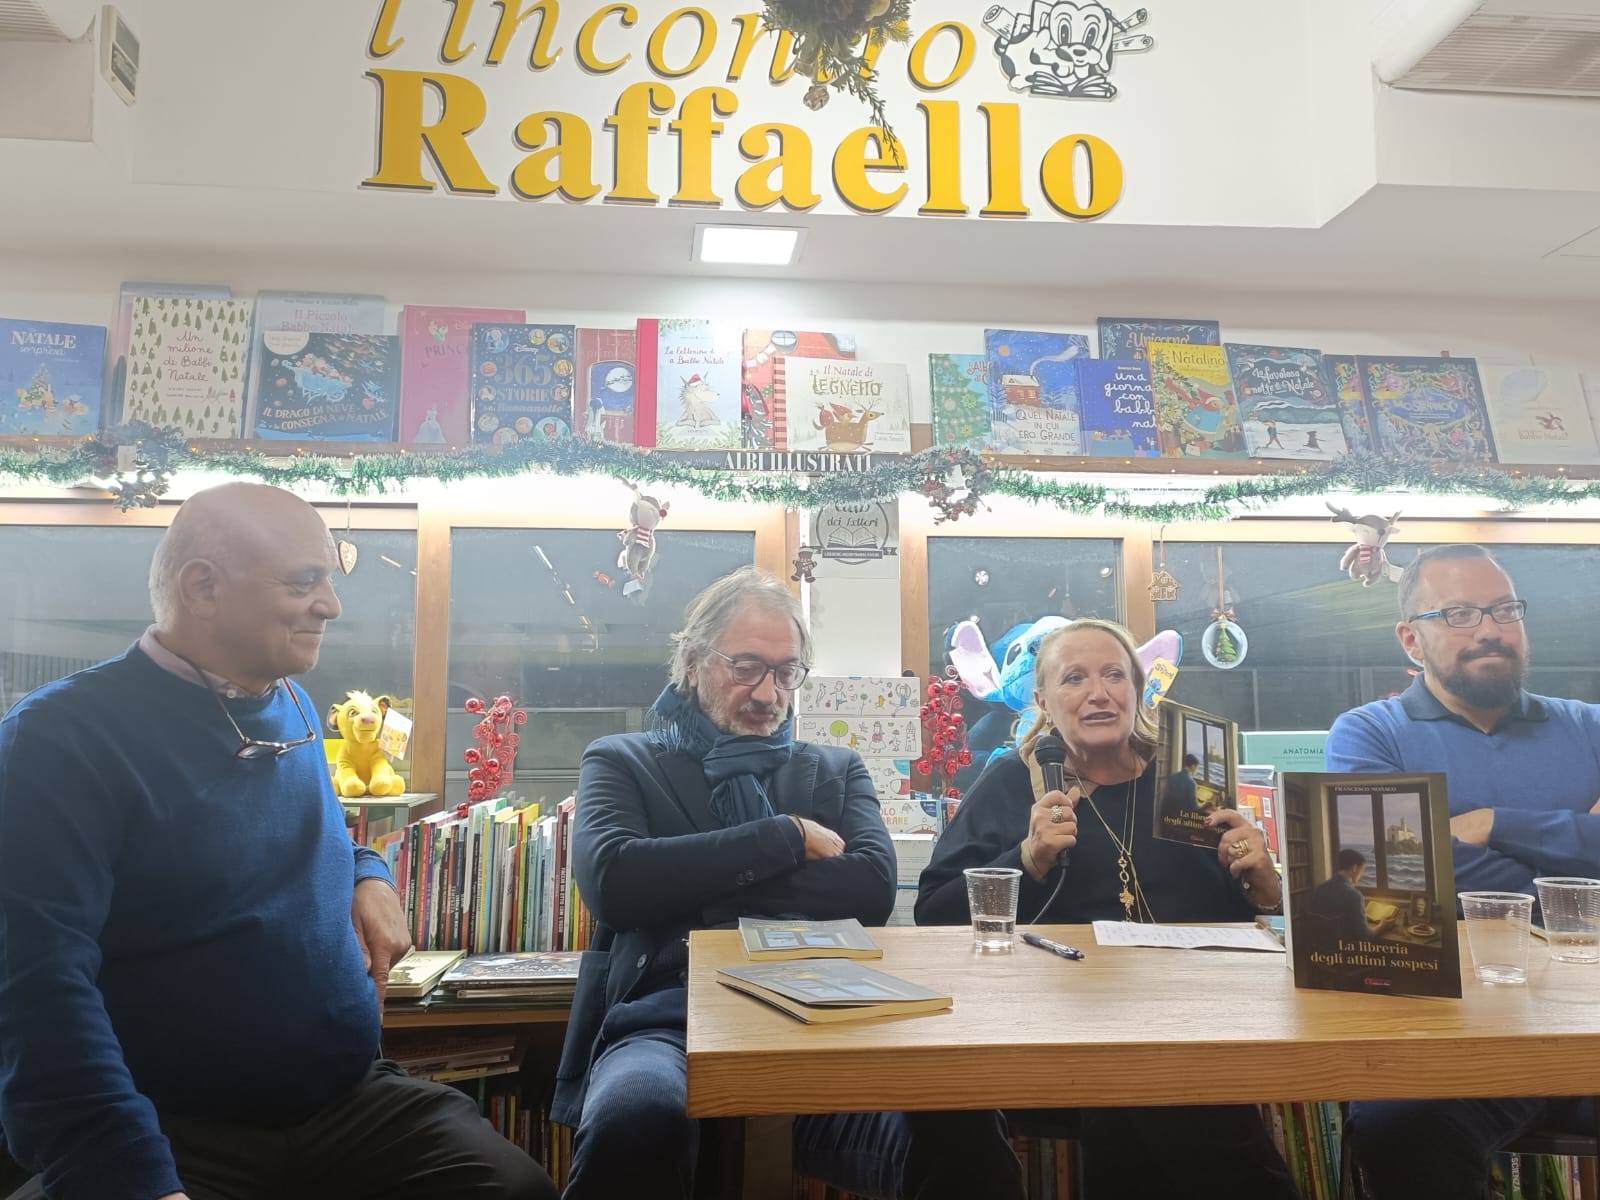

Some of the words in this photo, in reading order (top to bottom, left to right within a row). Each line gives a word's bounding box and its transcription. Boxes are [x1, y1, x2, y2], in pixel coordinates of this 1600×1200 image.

[359, 68, 1125, 221] Raffaello
[10, 330, 77, 349] NATALE
[1172, 351, 1225, 367] Natalino
[168, 368, 208, 382] Natale
[494, 353, 552, 386] 365
[834, 366, 863, 377] Natale
[812, 375, 883, 397] LEGNETTO
[496, 387, 550, 402] STORIE
[1119, 393, 1146, 401] con
[262, 407, 273, 417] IL
[275, 408, 310, 419] DRAGO
[313, 405, 324, 415] DI
[327, 403, 356, 414] NEVE
[281, 414, 337, 430] CONSEGNA
[347, 407, 390, 424] NATALE
[1015, 408, 1042, 420] QUEL
[1046, 409, 1077, 422] NATALE
[1046, 422, 1060, 430] CUI
[1018, 430, 1036, 440] ERO
[1040, 430, 1076, 441] GRANDE
[724, 452, 765, 470] ALBI
[771, 453, 871, 472] ILLUSTRATI
[827, 516, 842, 527] dei
[882, 816, 908, 825] RARE
[1338, 939, 1356, 951] La
[1359, 940, 1408, 955] libreria
[1310, 952, 1343, 966] degli
[1347, 953, 1386, 968] attimi
[1390, 957, 1438, 971] sospesi
[1512, 1157, 1521, 1192] SCIENZA
